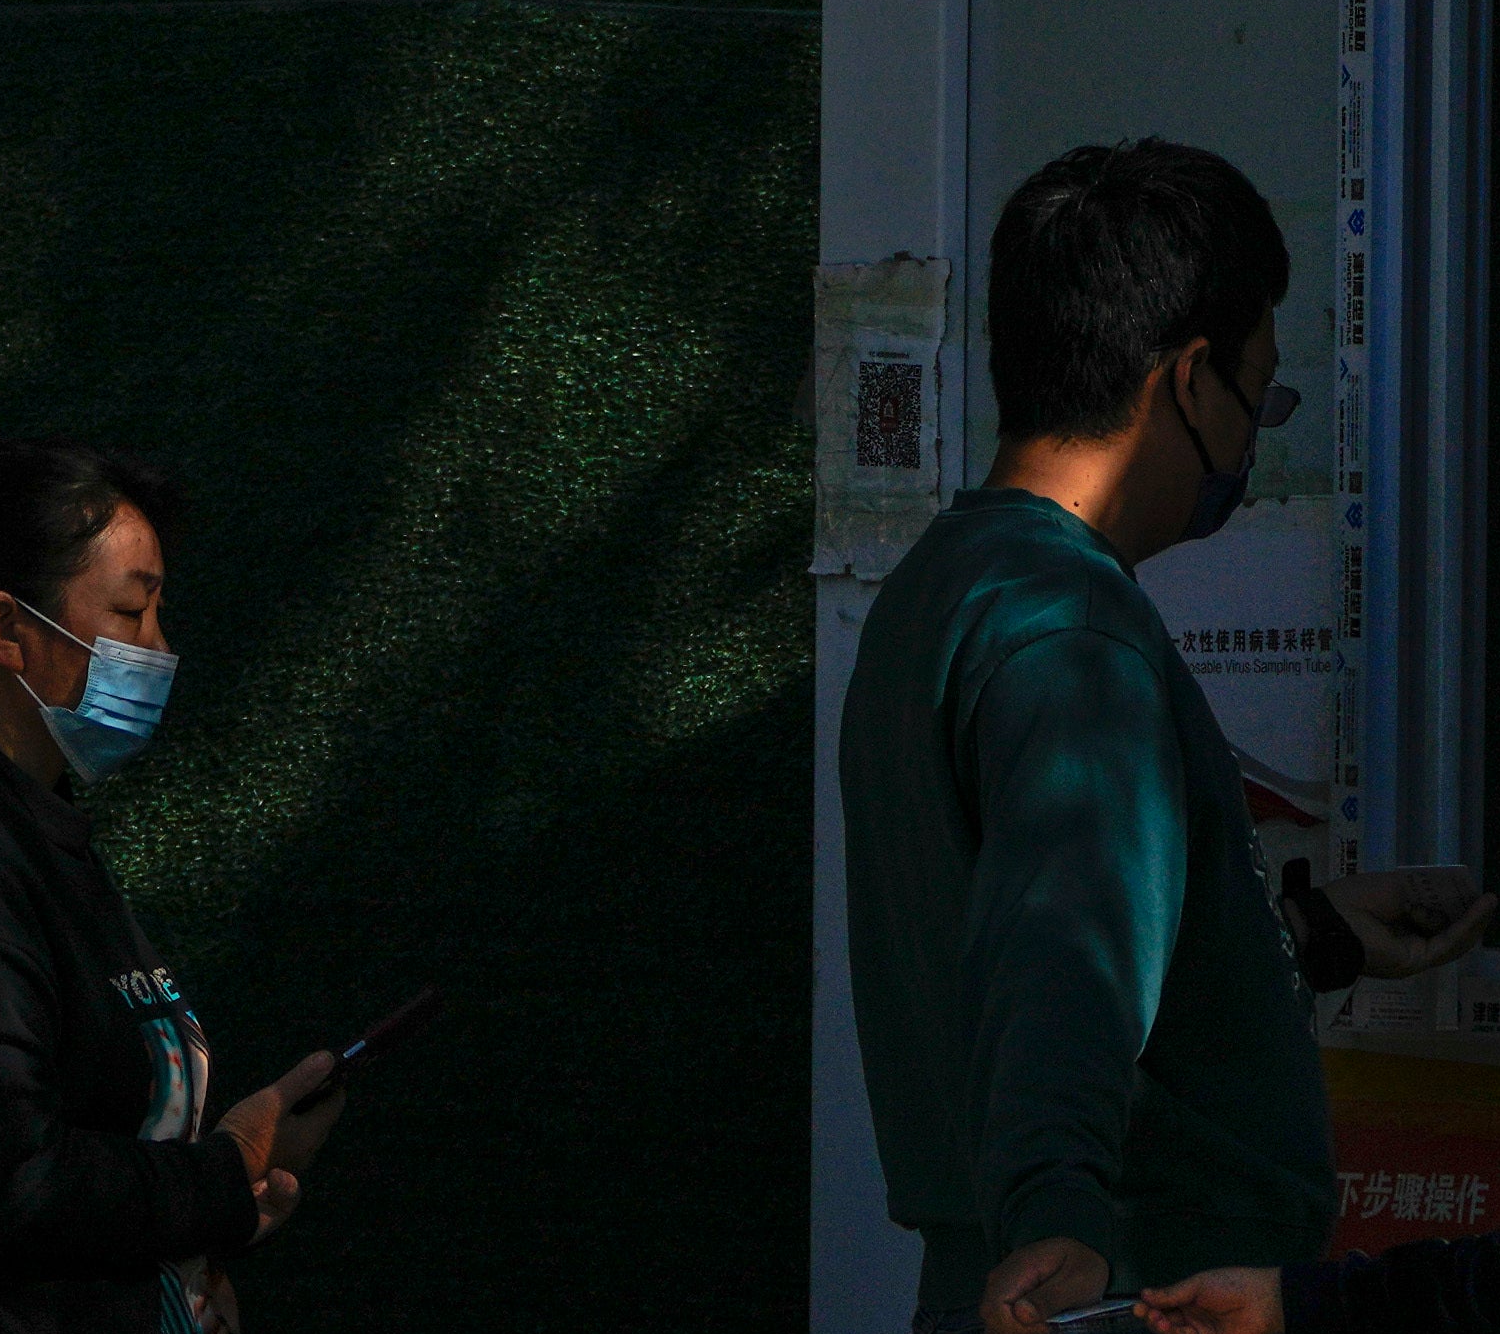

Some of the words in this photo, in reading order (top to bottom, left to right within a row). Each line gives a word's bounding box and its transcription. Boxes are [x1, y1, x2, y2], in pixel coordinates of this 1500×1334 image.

[1352, 252, 1365, 345] 津德型材
[1350, 546, 1362, 639] 津德型材
[1188, 659, 1222, 674] osable
[1225, 659, 1250, 674] Virus
[1254, 659, 1300, 676] Sampling
[1305, 658, 1331, 673] Tube
[1337, 1170, 1489, 1225] 下步骤操作
